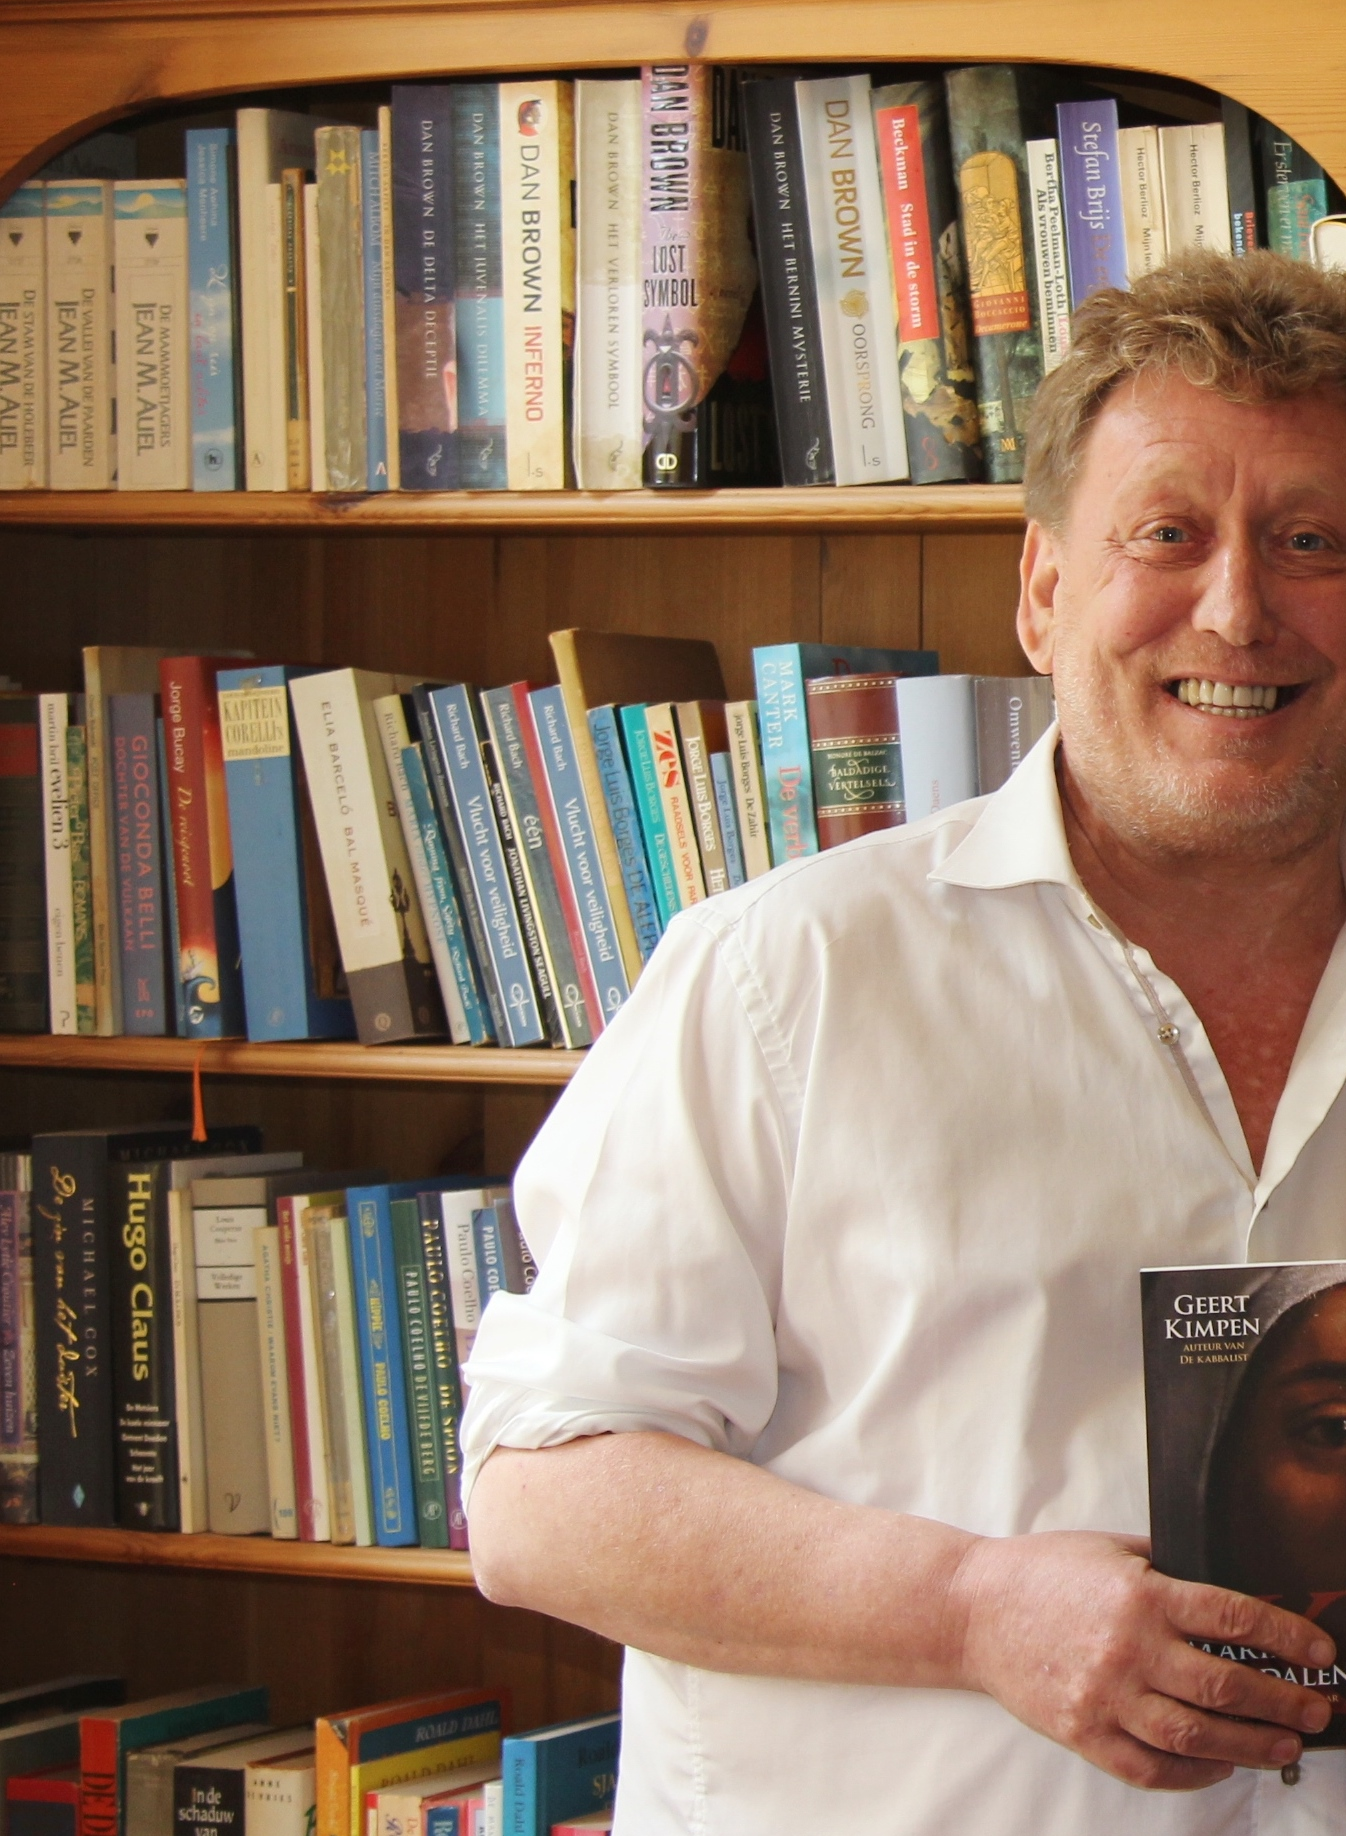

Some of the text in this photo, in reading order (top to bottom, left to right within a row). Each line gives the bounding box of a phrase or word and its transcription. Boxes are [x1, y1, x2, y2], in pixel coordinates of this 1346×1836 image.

[650, 64, 690, 212] DAN BROWN
[1074, 121, 1110, 181] Stefan
[1044, 152, 1061, 204] Bertha
[1135, 147, 1148, 182] Hector
[1189, 144, 1202, 179] Hector
[1078, 185, 1111, 230] Brijs
[1138, 183, 1151, 219] Berlioz
[1191, 181, 1205, 216] Berlioz
[890, 118, 925, 329] Beckman Stad in de storm
[1142, 228, 1155, 251] Mijn
[420, 120, 440, 380] DAN BROWN DE DELTA DECEPTIE
[471, 113, 491, 416] DAN BROWN HET JUVENALIS DILEMMA
[607, 112, 621, 410] DAN BROWN HET VERLOREN SYMBOOL
[652, 245, 686, 274] LOST
[768, 112, 812, 405] DAN BROWN HET BERNINI MYSTERIE
[823, 99, 876, 430] DAN BROWN OORSPRONG
[1035, 189, 1061, 353] Als vrouwen beminnen
[1048, 207, 1068, 309] Peelman-Loth
[520, 145, 545, 422] DAN BROWN INFERNO
[643, 277, 699, 308] SYMBOL
[22, 290, 36, 466] DE STAM VAN DE HOLEBEER
[54, 302, 80, 454] JEAN M. AUEL
[81, 288, 95, 467] DE VALLEI VAN DE PAARDEN
[132, 303, 158, 456] JEAN M. AUEL
[159, 305, 172, 449] DE MAMMOETJAGERS
[167, 681, 183, 722] Jorge
[761, 662, 784, 749] CANTER
[779, 661, 799, 722] MARK
[47, 703, 59, 742] martin
[49, 744, 62, 765] bril
[171, 726, 188, 774] Bucay
[593, 725, 614, 769] Jorge
[634, 730, 650, 761] JORGE
[684, 736, 703, 774] JORGE
[739, 740, 750, 760] Luis
[497, 703, 546, 850] Richard Bach één
[606, 772, 623, 803] Luis
[640, 761, 652, 782] LUIS
[692, 774, 706, 801] LUIS
[741, 761, 753, 794] Borges
[49, 768, 69, 834] evelien
[176, 787, 194, 809] De
[319, 701, 373, 930] ELIA BARCELÓ BAL MASQUÉ
[643, 783, 661, 824] BORGES
[653, 730, 682, 789] zes
[670, 796, 687, 850] RAADSELS
[681, 853, 694, 882] VOOR
[745, 797, 755, 811] De
[778, 766, 808, 862] De verb
[52, 838, 68, 850] 3
[114, 736, 136, 951] DOCHTER VAN DE VULKAAN
[130, 735, 157, 951] GIOCONDA BELLI
[445, 704, 518, 960] Richard Bach Vlucht voor veiligheid
[543, 704, 558, 741] Richard
[551, 745, 565, 771] Bach
[563, 797, 587, 849] Vlucht
[577, 852, 592, 886] voor
[587, 891, 614, 963] veiligheid
[612, 806, 637, 867] Borges
[695, 802, 716, 852] BORGES
[747, 812, 760, 839] Zahir
[492, 782, 553, 999] RICHARD BACH JONATHAN LIVINGSTON SEAGULL
[628, 870, 646, 895] DE
[51, 1165, 77, 1206] De
[261, 1245, 271, 1283] AGATHA
[420, 1219, 442, 1284] PAULO
[482, 1225, 499, 1265] PAULO
[82, 1197, 99, 1378] MICHAEL COX
[121, 1172, 155, 1382] Hugo Claus
[456, 1223, 478, 1323] Paulo Coelho
[54, 1298, 77, 1343] het
[263, 1286, 274, 1329] CHRISTIE
[1173, 1294, 1250, 1316] GEERT
[428, 1289, 453, 1369] COELHO
[1164, 1317, 1260, 1339] KIMPEN
[1183, 1341, 1245, 1352] AUTEUR VAN
[267, 1336, 278, 1376] WAAROM
[403, 1271, 436, 1475] PAULO COELHO DE VIJFDE BERG
[1180, 1353, 1249, 1364] DE KABBALIST
[270, 1380, 280, 1410] EVANS
[374, 1362, 389, 1396] PAULO
[438, 1384, 454, 1410] DE
[376, 1398, 392, 1440] COELHO
[414, 1708, 499, 1745] ROALD DAHL
[178, 1805, 236, 1823] schaduw
[191, 1786, 223, 1805] in de
[514, 1758, 527, 1834] Roald Dahl
